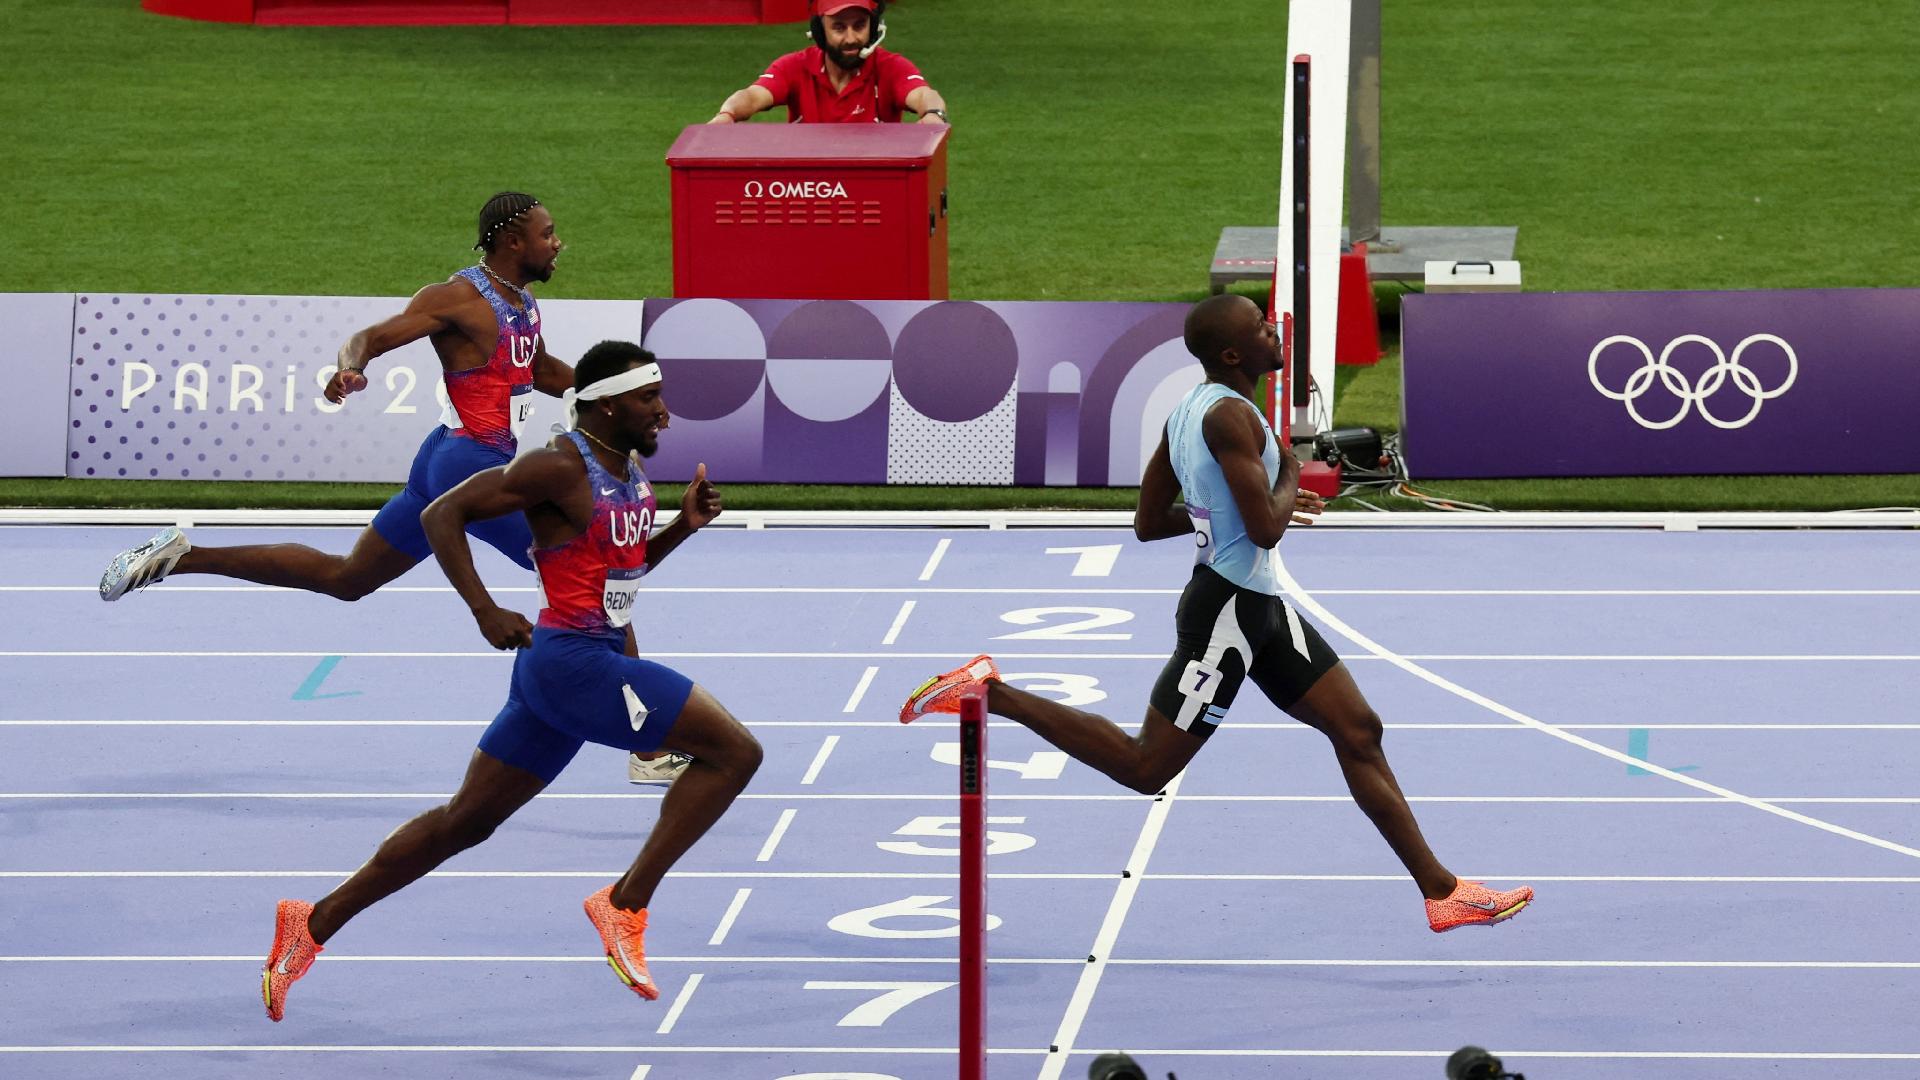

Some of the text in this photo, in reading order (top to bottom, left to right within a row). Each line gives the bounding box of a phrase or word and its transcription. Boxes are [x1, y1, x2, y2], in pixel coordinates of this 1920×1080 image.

[768, 181, 849, 198] OMEGA
[610, 507, 651, 548] USA
[1045, 543, 1124, 577] 1
[988, 606, 1136, 640] 2
[1193, 669, 1212, 692] 7
[875, 816, 1037, 856] 5
[826, 895, 1003, 939] 6
[802, 981, 961, 1027] 7
